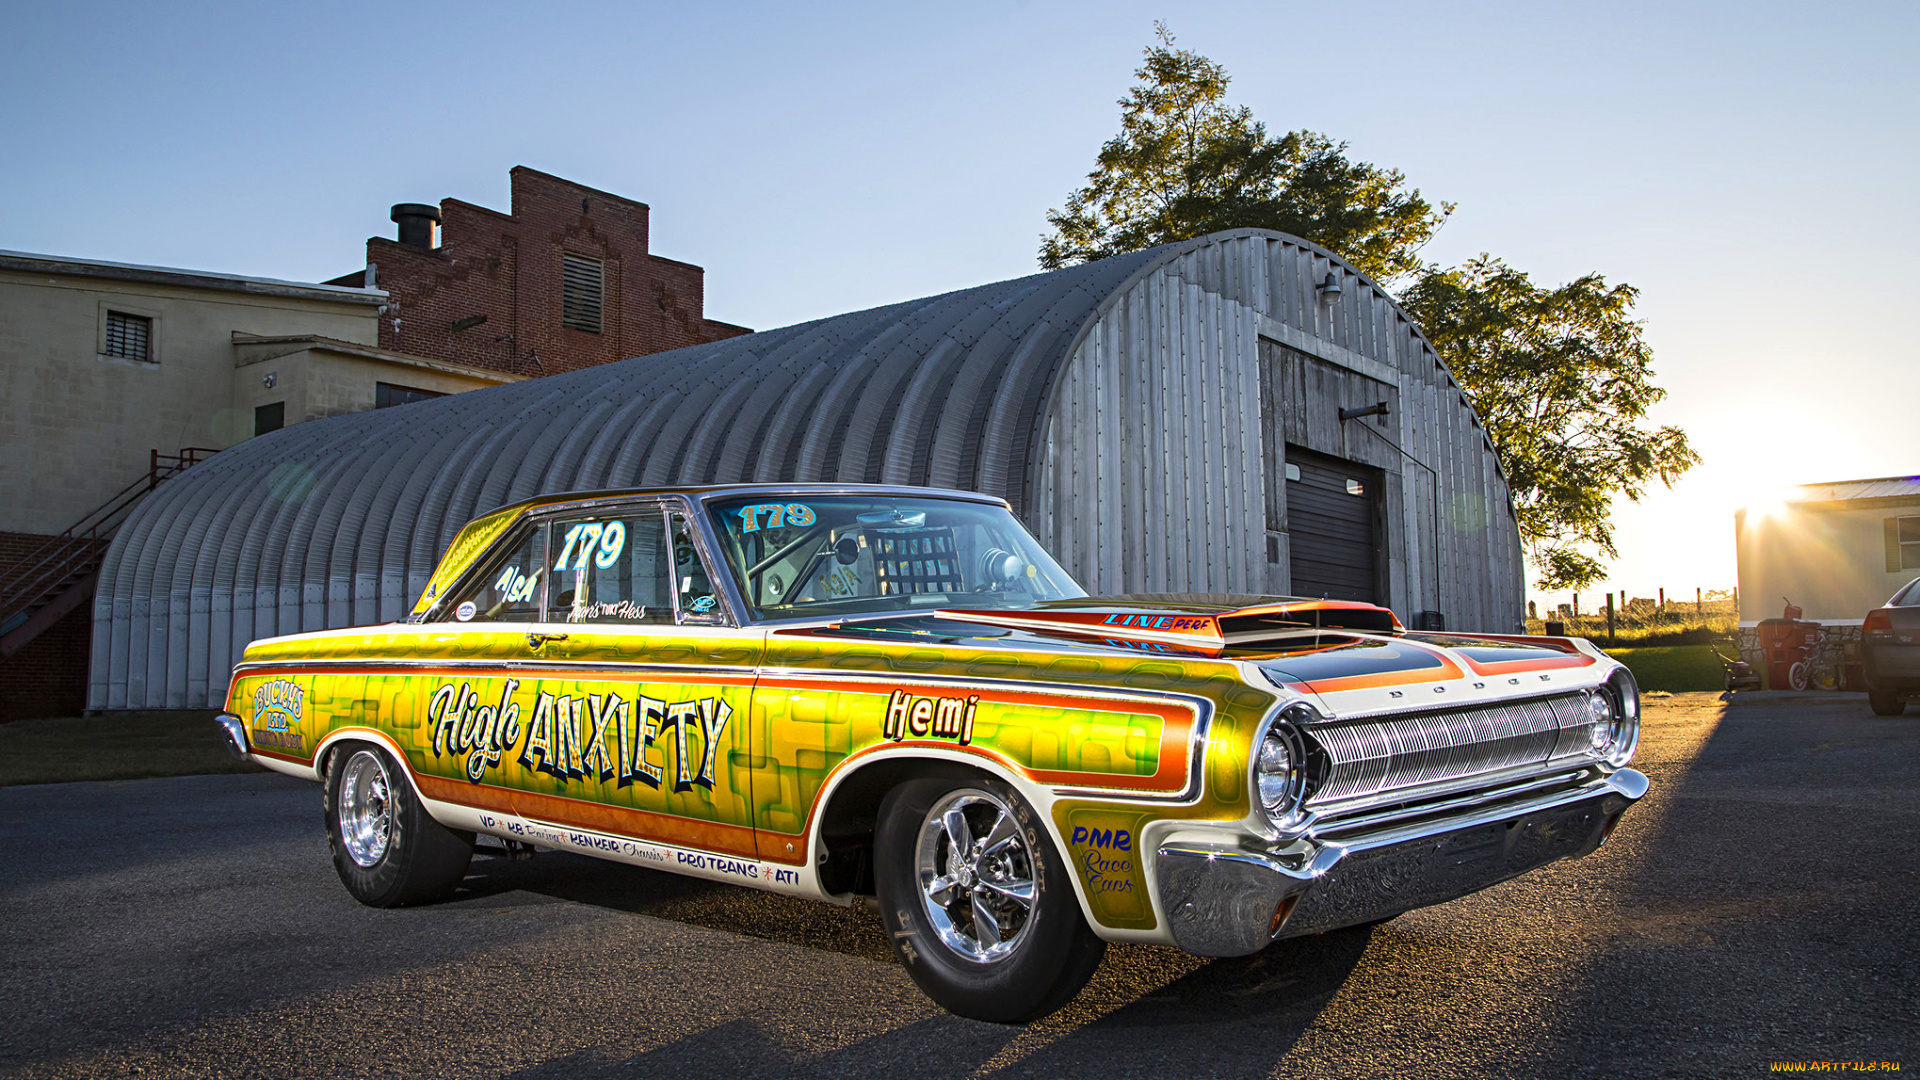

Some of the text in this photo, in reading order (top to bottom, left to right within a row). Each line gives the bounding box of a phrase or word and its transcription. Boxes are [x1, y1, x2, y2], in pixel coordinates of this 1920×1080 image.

[738, 503, 816, 534] 179
[553, 520, 627, 572] 179
[494, 566, 538, 603] A/SA
[618, 600, 647, 619] Hess
[1104, 614, 1211, 631] LINE PERF
[1389, 675, 1551, 698] DODGE
[883, 689, 980, 746] Hemi
[428, 678, 734, 794] High ANXIETY
[1071, 826, 1132, 852] PMR
[1078, 849, 1134, 875] Race
[775, 869, 799, 886] ATI
[1085, 869, 1135, 895] Cars
